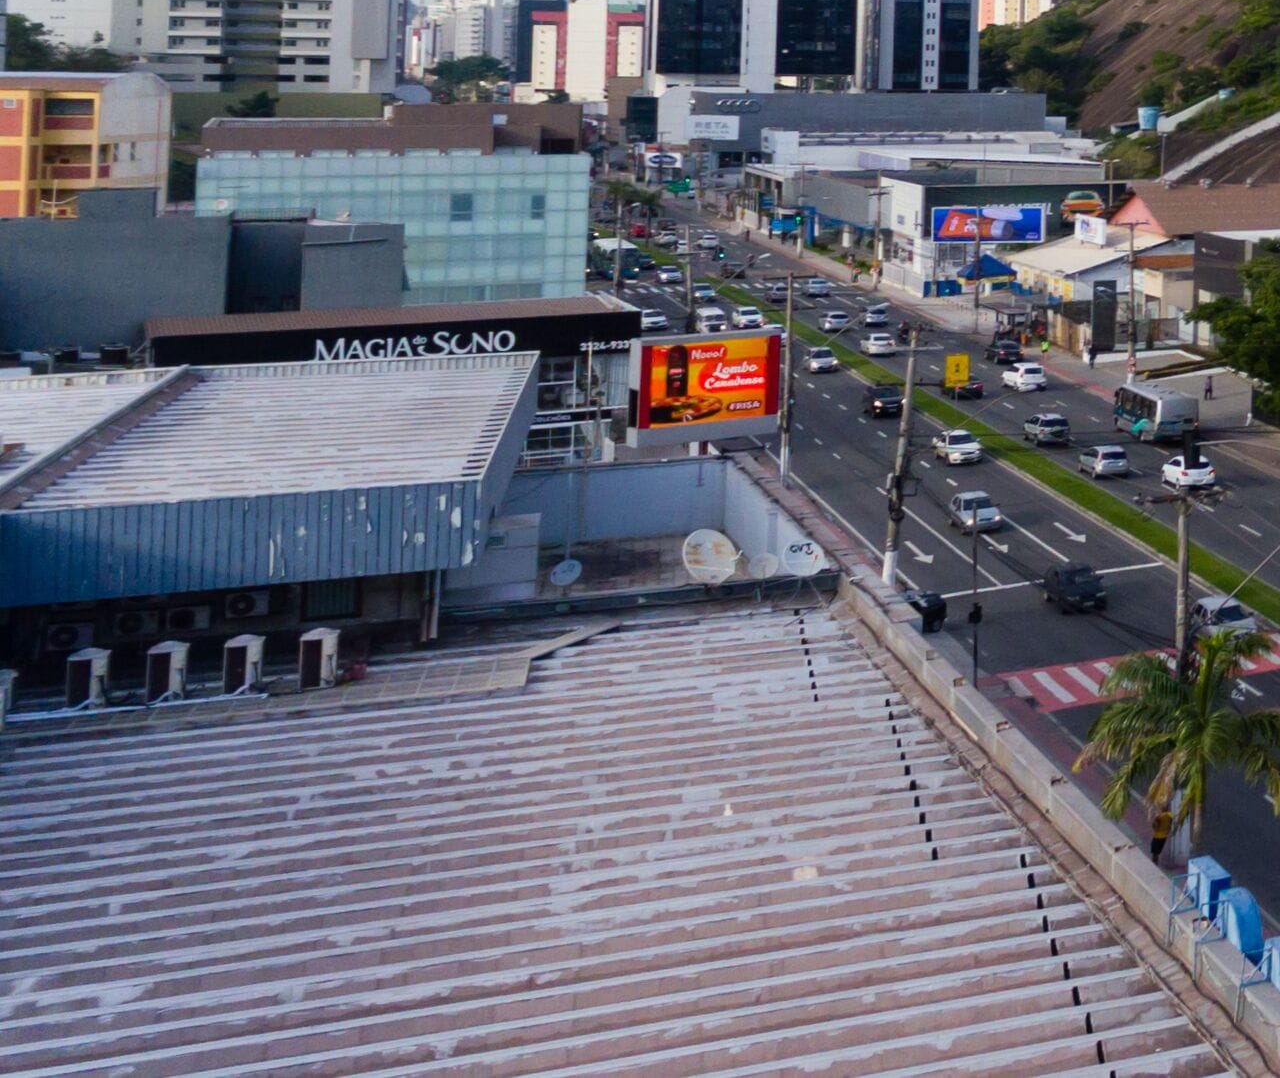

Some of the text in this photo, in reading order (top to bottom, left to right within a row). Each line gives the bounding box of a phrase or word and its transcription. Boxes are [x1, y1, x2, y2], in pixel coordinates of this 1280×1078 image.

[314, 338, 410, 361] MAGIA
[712, 361, 759, 379] Lombo
[704, 376, 765, 390] Canadense
